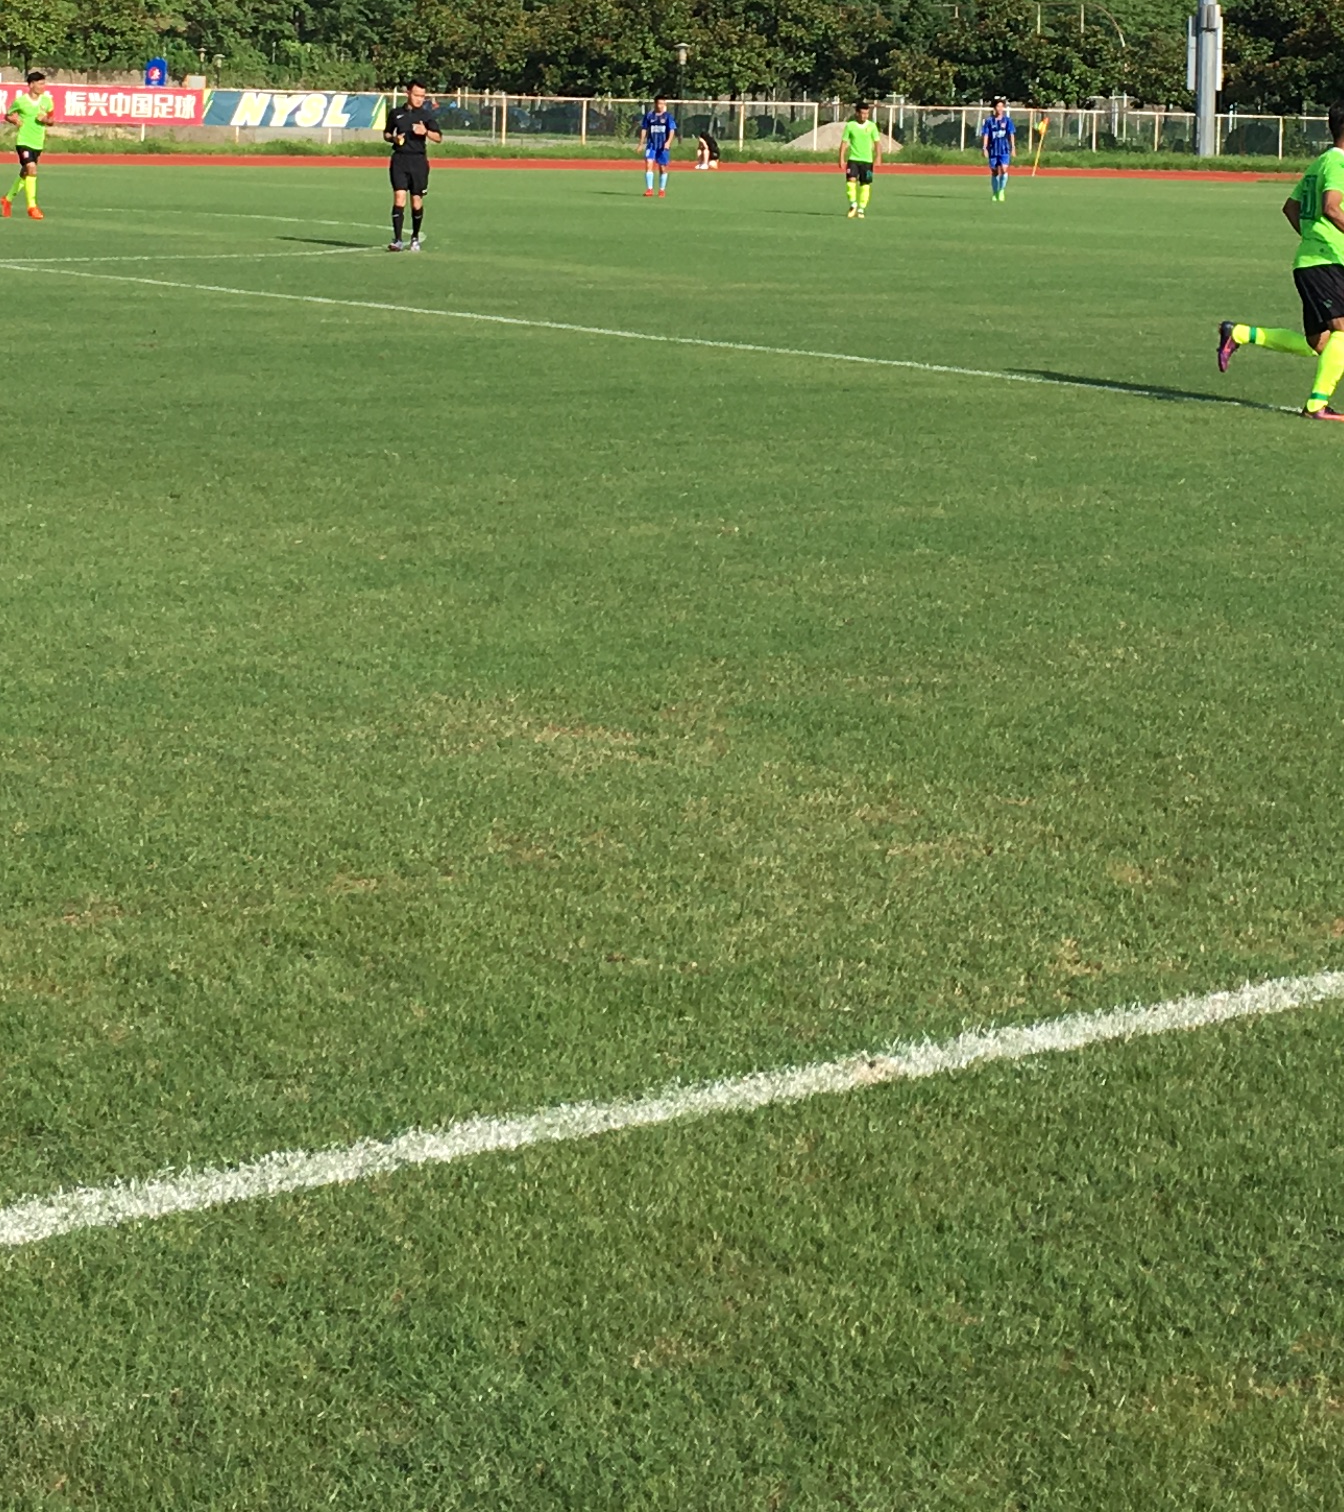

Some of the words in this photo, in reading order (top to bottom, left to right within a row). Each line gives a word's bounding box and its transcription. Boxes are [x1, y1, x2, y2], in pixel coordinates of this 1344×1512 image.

[64, 91, 196, 120] 振兴中国足球
[230, 92, 350, 127] NYSL
